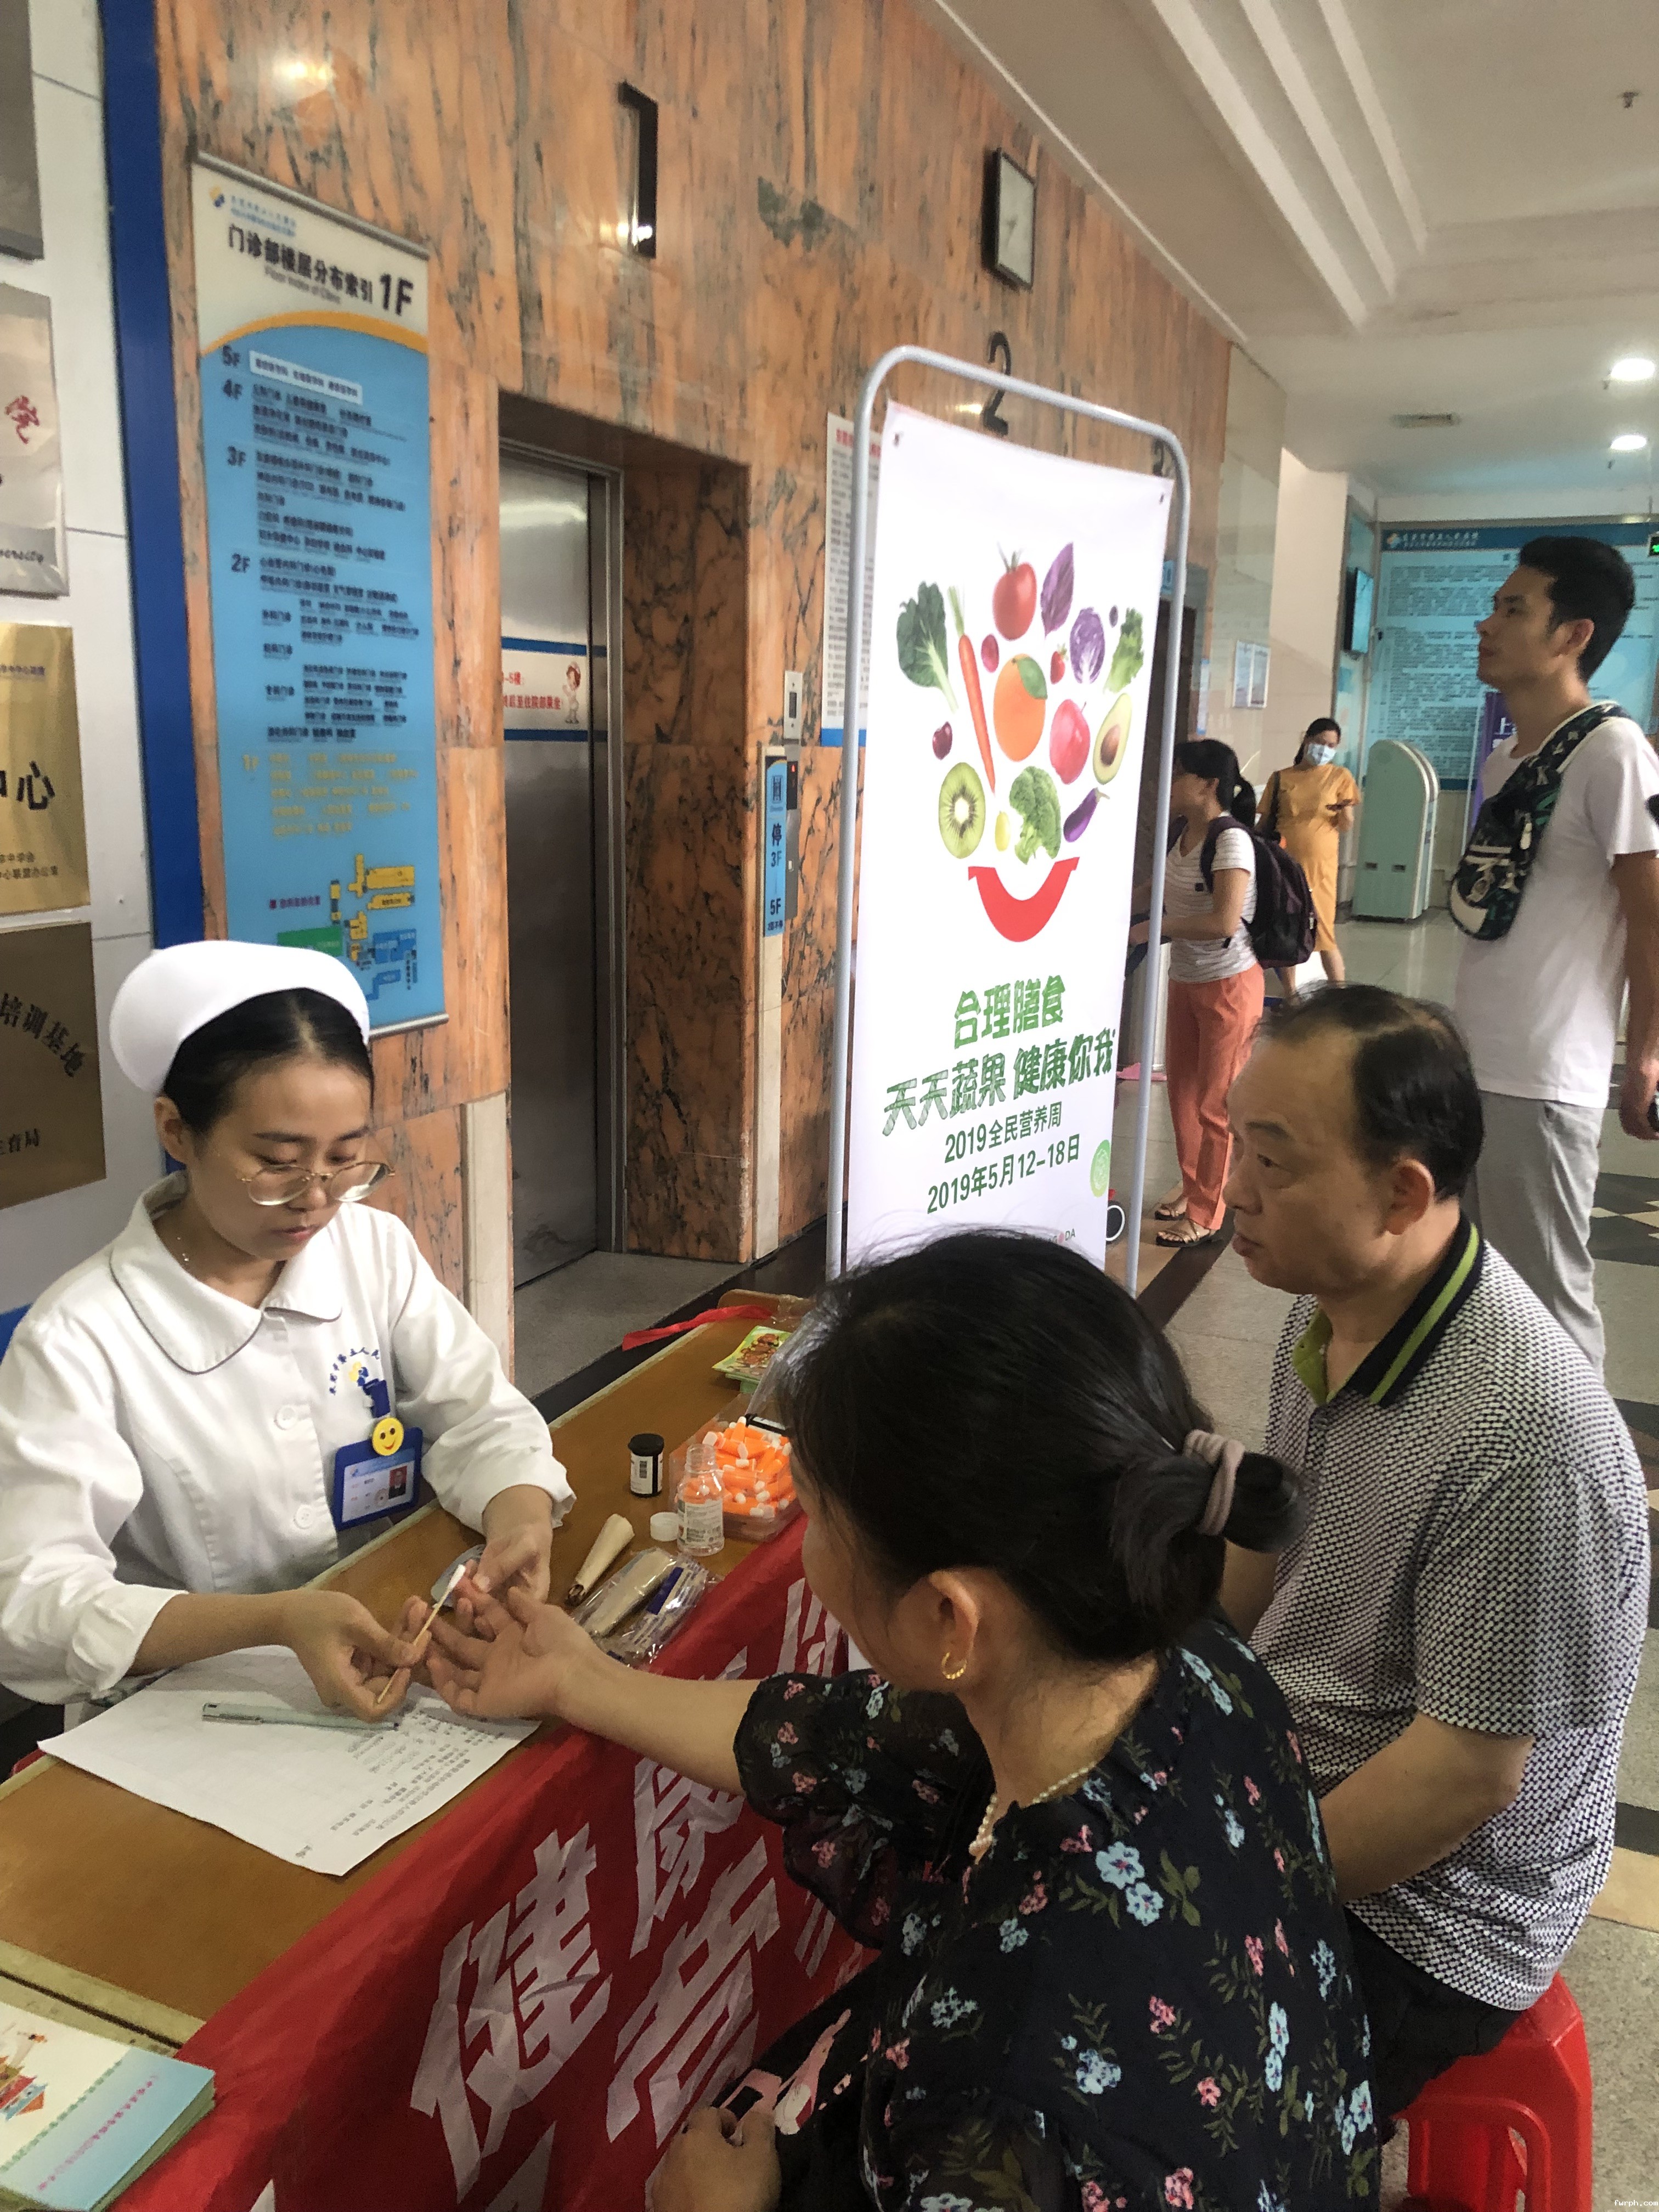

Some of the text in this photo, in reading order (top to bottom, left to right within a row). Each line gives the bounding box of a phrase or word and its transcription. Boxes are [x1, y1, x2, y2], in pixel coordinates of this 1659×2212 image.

[380, 274, 413, 315] 1F
[223, 379, 243, 400] 4F
[228, 445, 246, 466] 3F
[232, 554, 250, 573] 2F
[771, 851, 782, 867] 3F
[770, 898, 781, 916] 5F
[954, 975, 1065, 1048] 合理膳食
[882, 1027, 1115, 1136] 天天蔬果 健康你我
[945, 1101, 1062, 1163] 2019全民营养周
[927, 1134, 1080, 1214] 2019年5月12-18日
